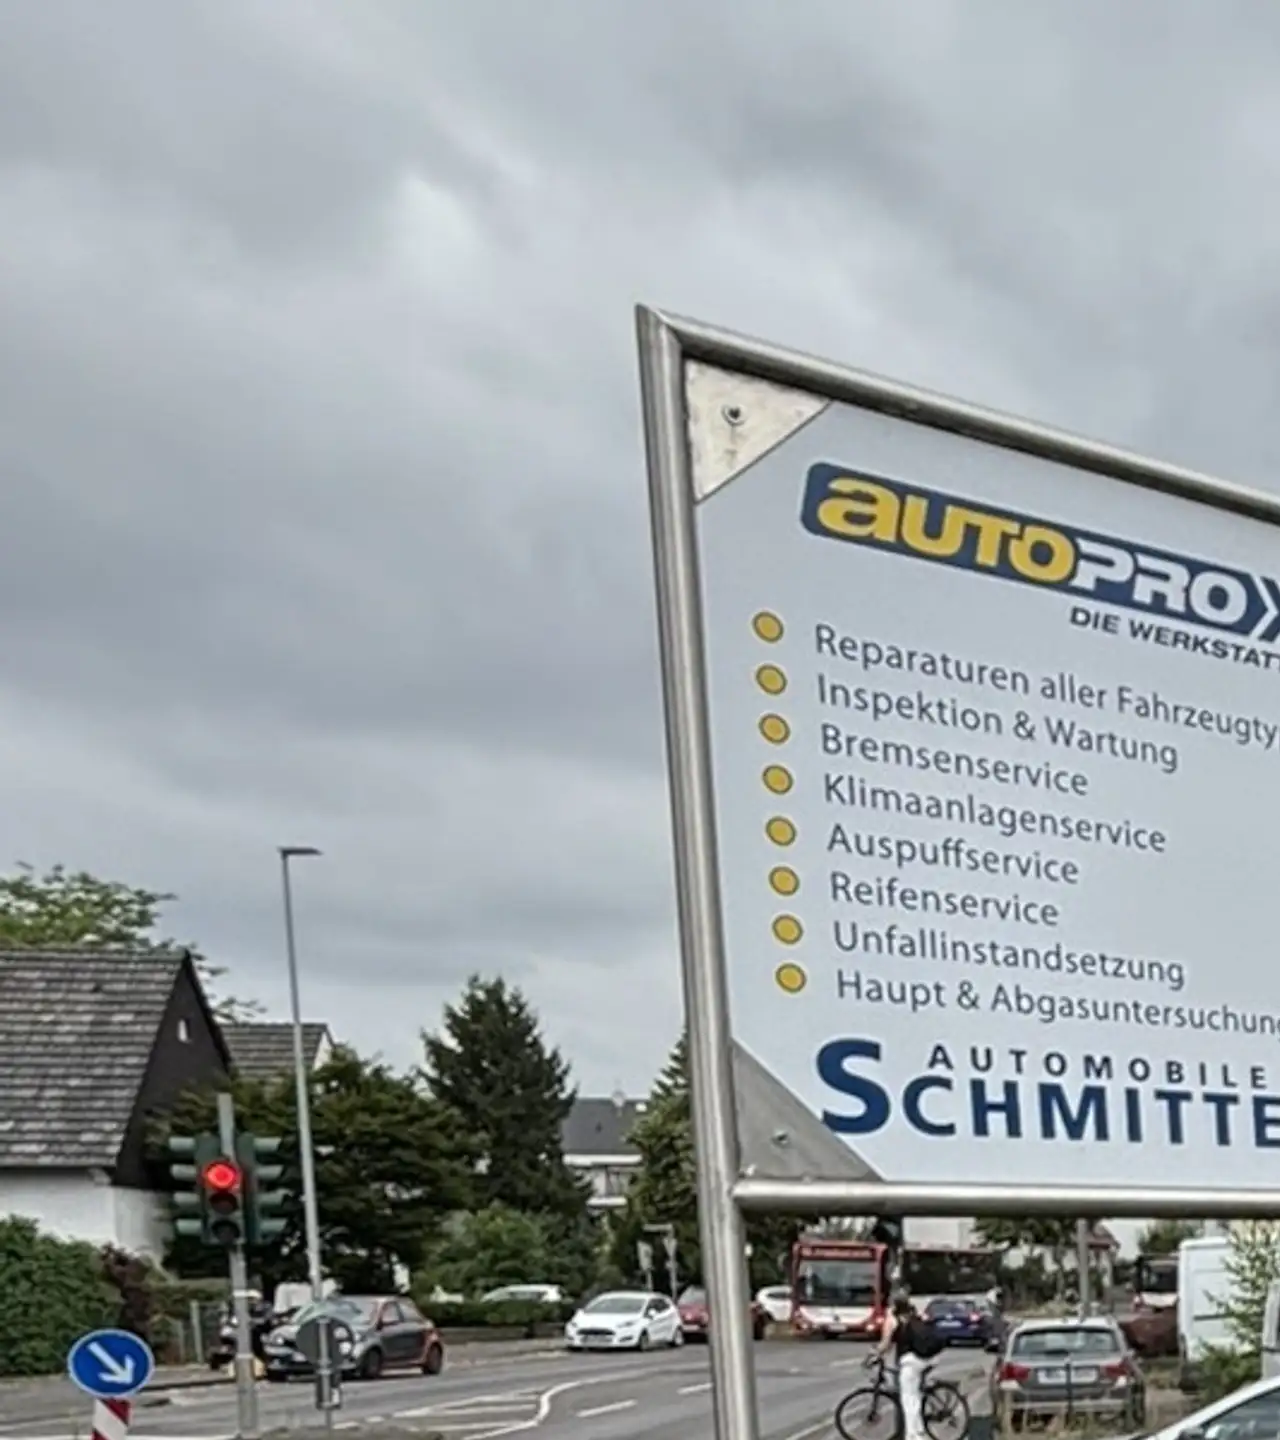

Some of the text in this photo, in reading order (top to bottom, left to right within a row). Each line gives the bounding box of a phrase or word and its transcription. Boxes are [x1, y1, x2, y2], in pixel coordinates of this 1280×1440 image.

[1070, 605, 1120, 635] DIE
[815, 624, 1029, 695] Reparaturen
[1041, 673, 1107, 711] aller
[817, 674, 1178, 773] Inspektion & Wartung
[821, 723, 1089, 796] Bremsenservice
[824, 773, 1167, 853] Klimaanlagenservice
[827, 823, 1080, 884] Auspuffservice
[830, 873, 1060, 927] Reifenservice
[834, 921, 1186, 991] Unfallinstandsetzung
[837, 971, 946, 1013] Haupt
[957, 981, 980, 1011] &
[929, 1045, 1268, 1089] AUTOMOBILE
